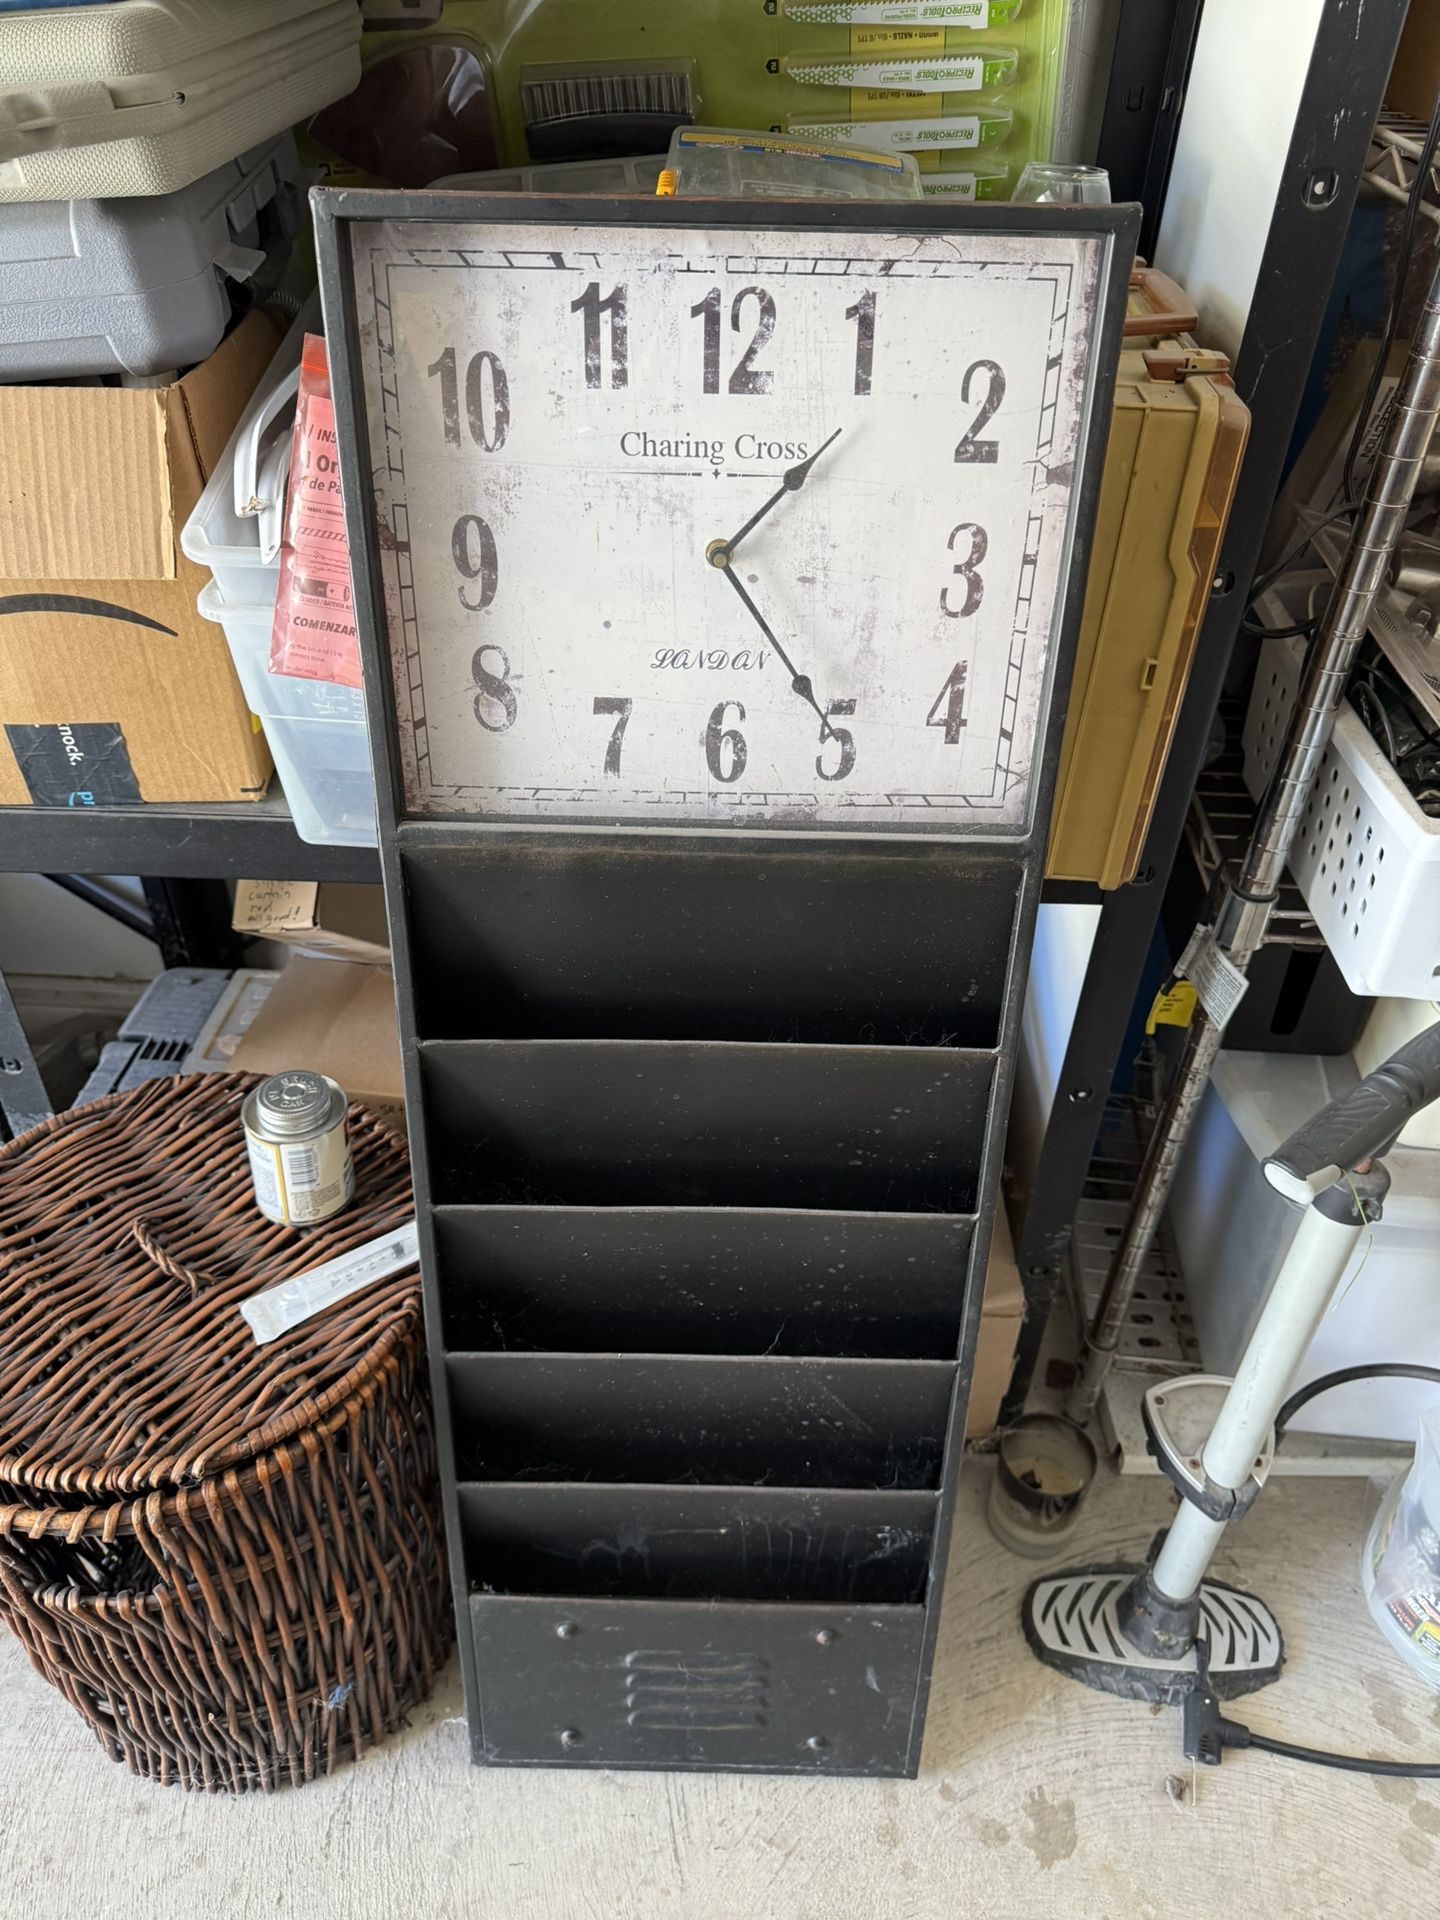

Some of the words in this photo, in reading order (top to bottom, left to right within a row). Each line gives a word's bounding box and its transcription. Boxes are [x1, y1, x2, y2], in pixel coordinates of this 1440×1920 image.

[571, 282, 628, 389] 11
[691, 286, 776, 394] 12
[846, 288, 877, 395] 1
[428, 347, 511, 452] 10
[954, 359, 1006, 463] 2
[620, 432, 726, 464] Charing
[735, 433, 808, 460] Cross
[451, 514, 498, 611] 9
[939, 522, 988, 618] 3
[293, 616, 356, 636] COMENZAR
[471, 644, 517, 732] 8
[926, 660, 968, 744] 4
[58, 723, 84, 766] nock.
[593, 697, 633, 778] 7
[705, 700, 747, 783] 6
[815, 699, 857, 781] 5
